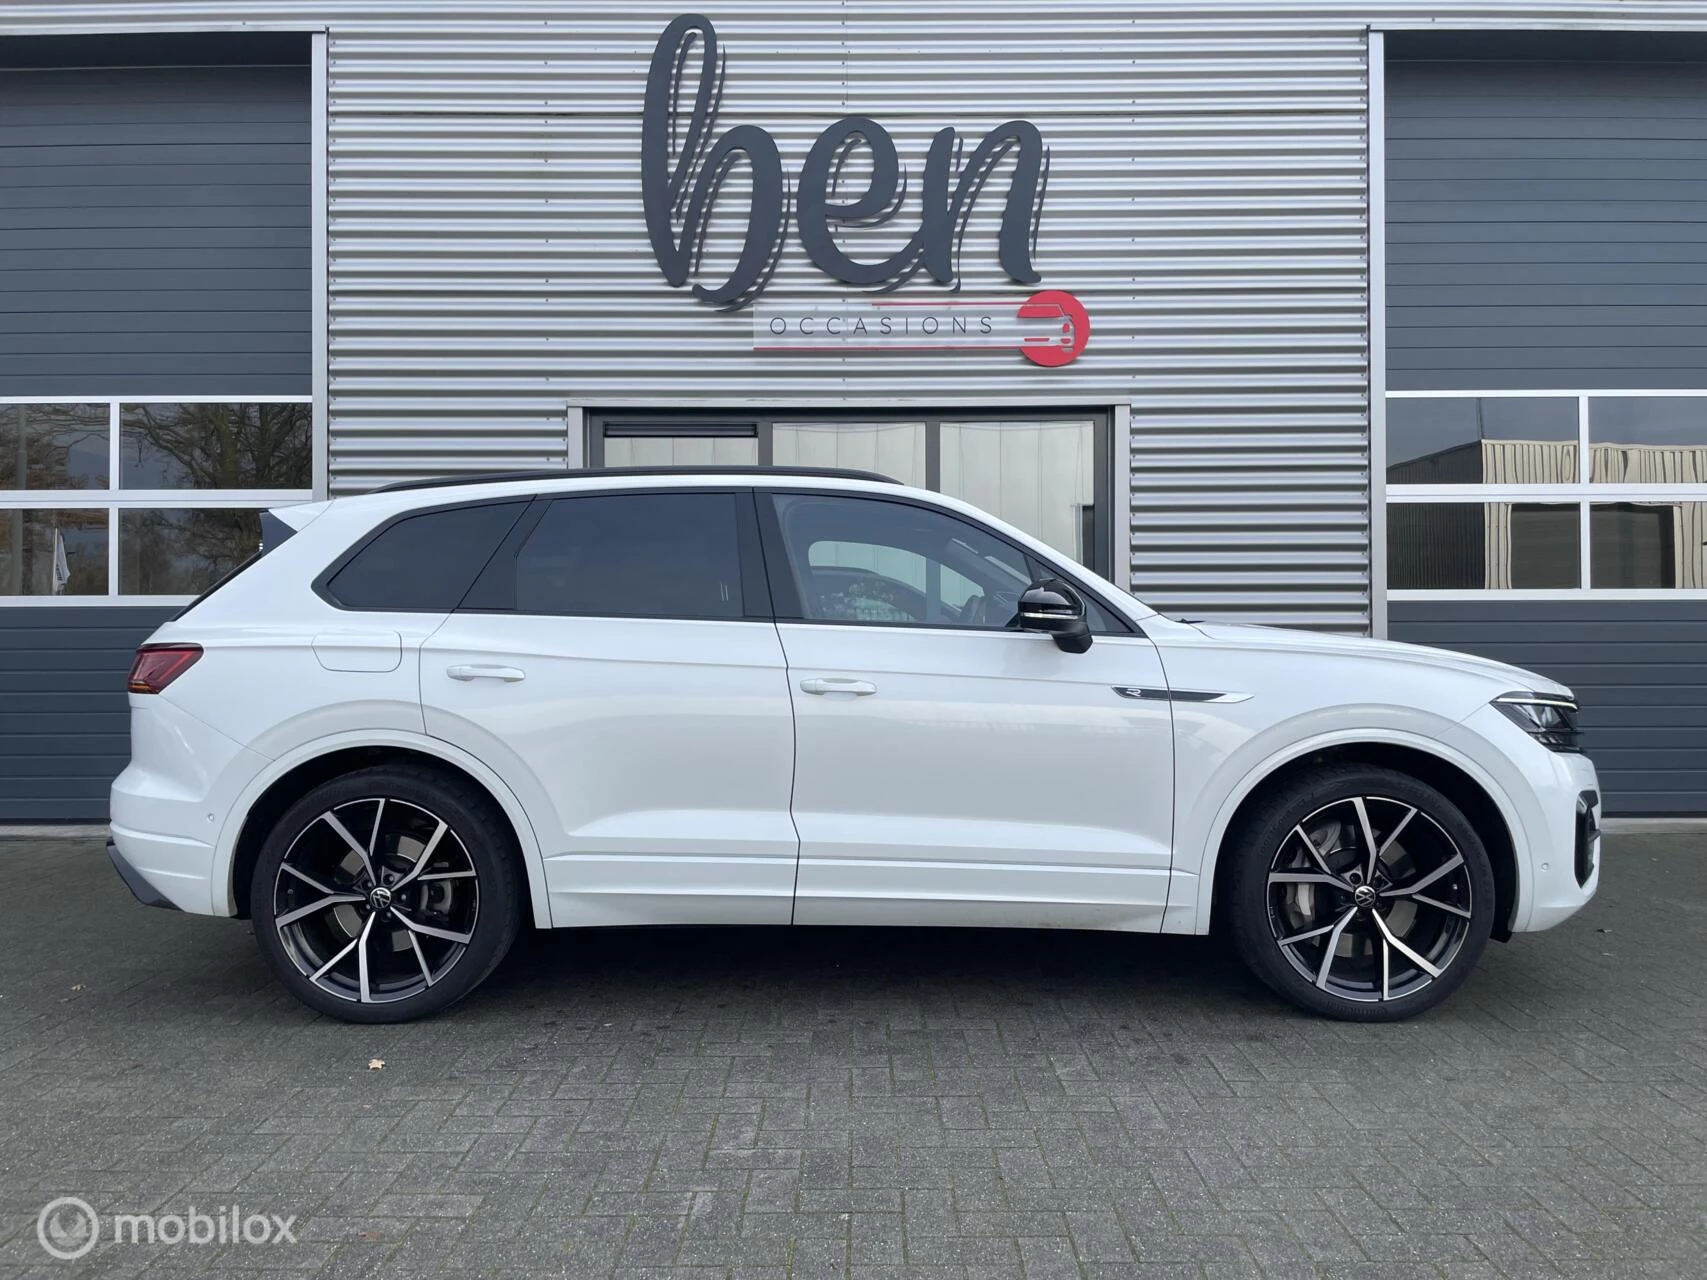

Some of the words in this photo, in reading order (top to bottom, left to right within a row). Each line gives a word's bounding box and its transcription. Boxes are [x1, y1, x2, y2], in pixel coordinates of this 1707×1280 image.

[641, 13, 1049, 312] ben
[769, 316, 993, 336] OCCASIONS
[1126, 688, 1141, 697] R
